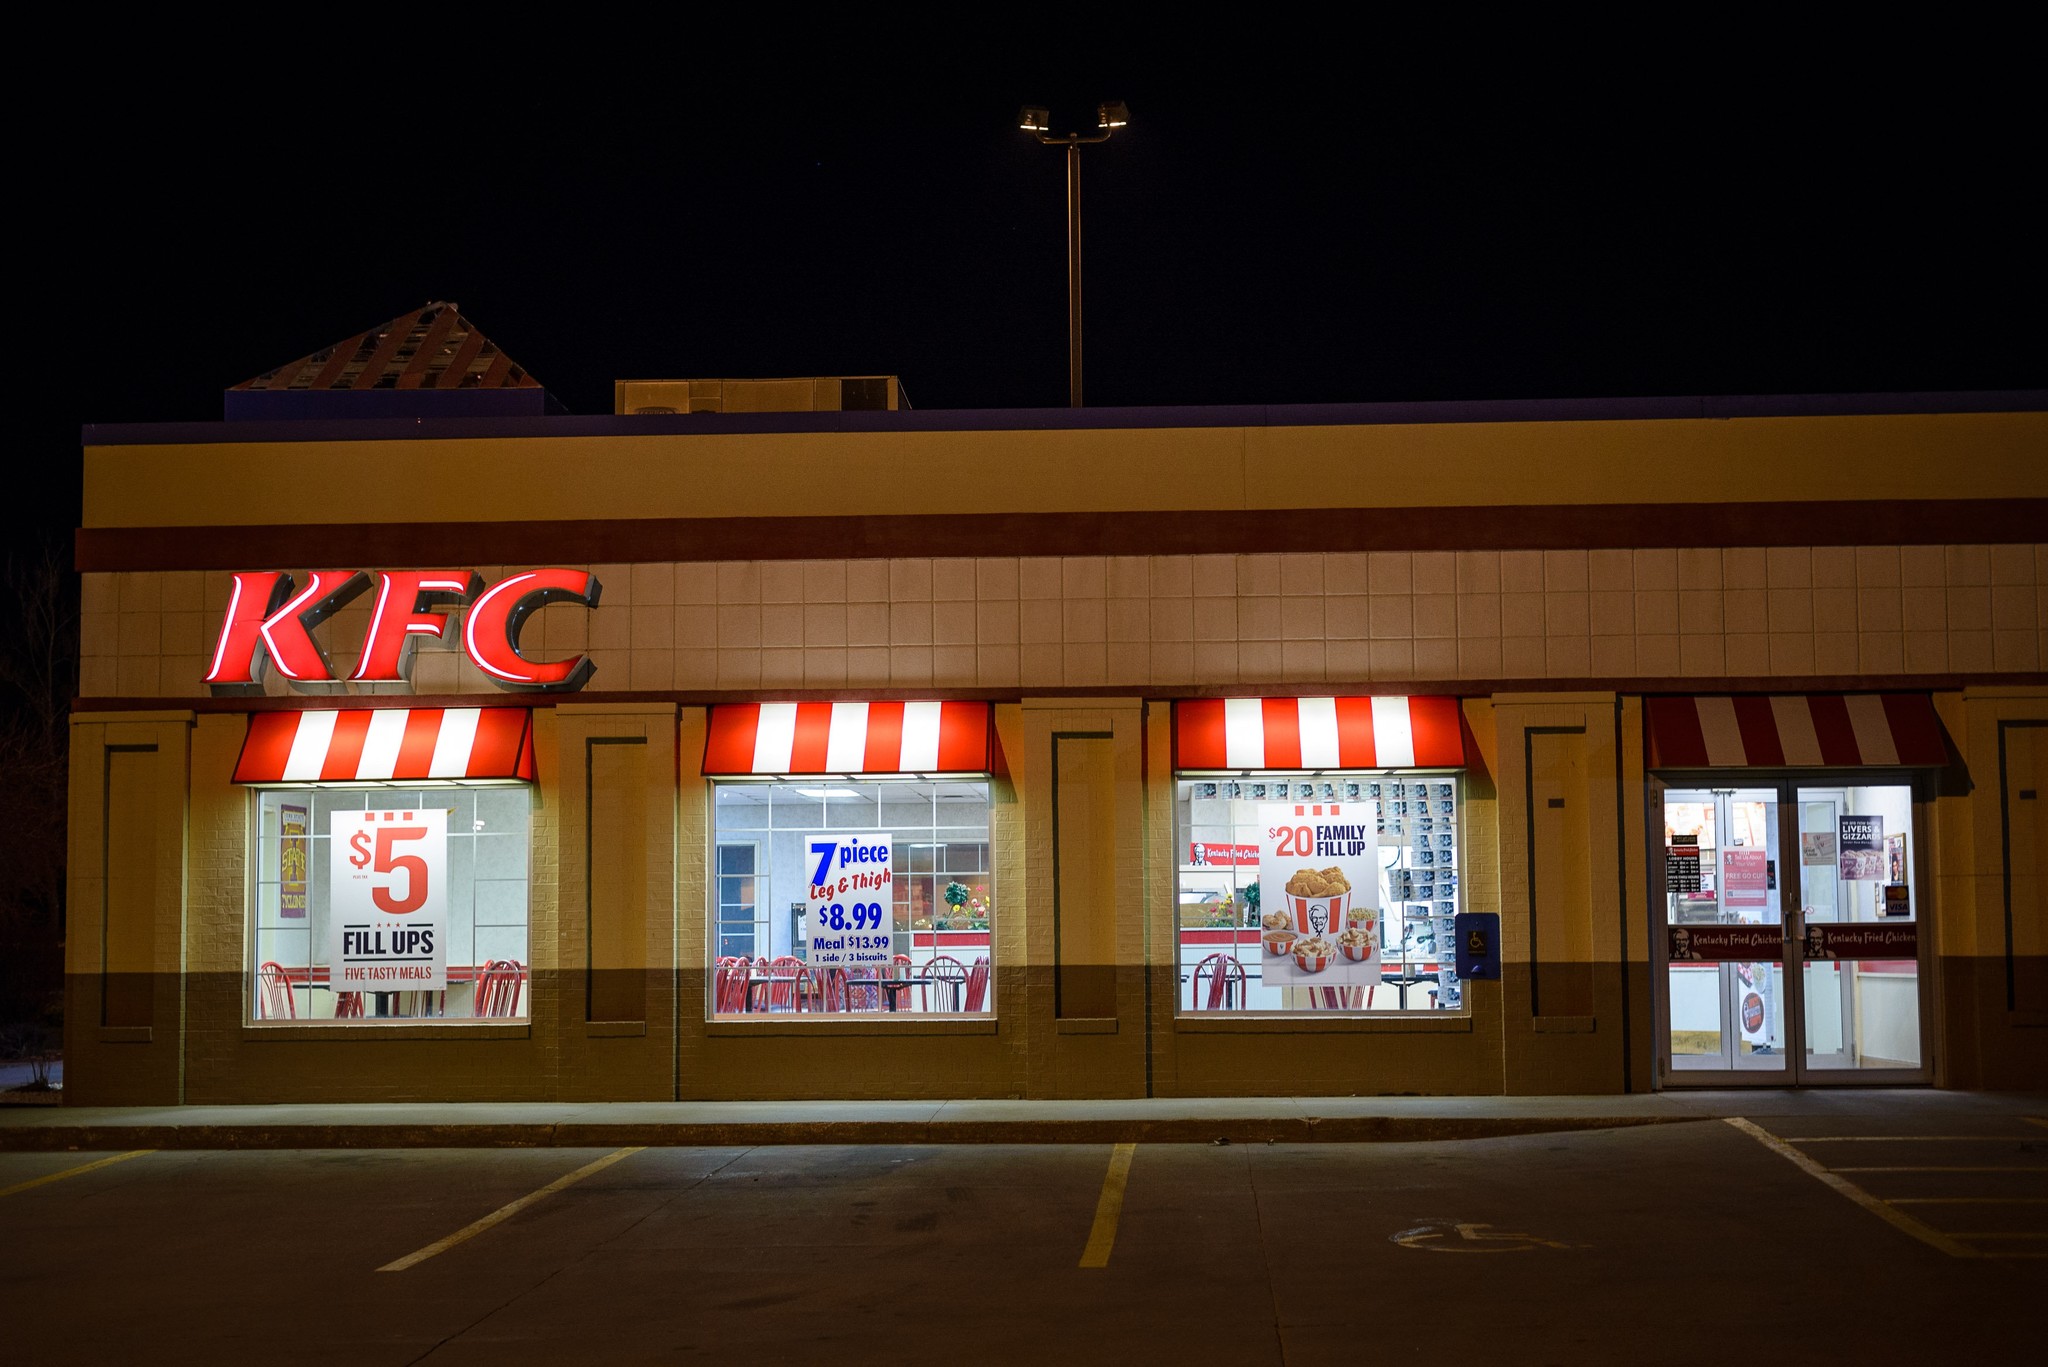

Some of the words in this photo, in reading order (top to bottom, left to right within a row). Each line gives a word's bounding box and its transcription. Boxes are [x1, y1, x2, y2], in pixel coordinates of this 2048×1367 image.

[200, 567, 602, 690] KFC
[1316, 825, 1366, 840] FAMILY
[1842, 825, 1872, 833] LIVERS
[1268, 826, 1313, 857] $20
[1842, 833, 1880, 841] GIZZARDS
[1316, 841, 1345, 856] FILL
[1347, 841, 1365, 856] UP
[810, 842, 838, 887] 7
[840, 837, 889, 869] piece
[349, 827, 428, 915] $5
[810, 884, 835, 902] Leg
[838, 876, 849, 894] &
[852, 867, 891, 891] Thigh
[1890, 903, 1908, 911] VISA
[819, 902, 882, 931] $8.99
[343, 931, 387, 955] FILL
[392, 930, 434, 954] UPS
[813, 936, 845, 950] Meal
[848, 935, 889, 949] $13.99
[1693, 934, 1728, 946] Kentucky
[1729, 933, 1750, 946] Fried
[1751, 933, 1781, 947] Chicken
[1827, 932, 1862, 945] Kentucky
[1864, 931, 1884, 944] Fried
[1885, 931, 1916, 944] Chicken
[815, 954, 819, 962] 1
[822, 953, 840, 962] side
[848, 953, 855, 962] 3
[856, 952, 888, 962] biscuits
[345, 967, 366, 980] FIVE
[367, 967, 398, 980] TASTY
[399, 966, 432, 979] MEALS
